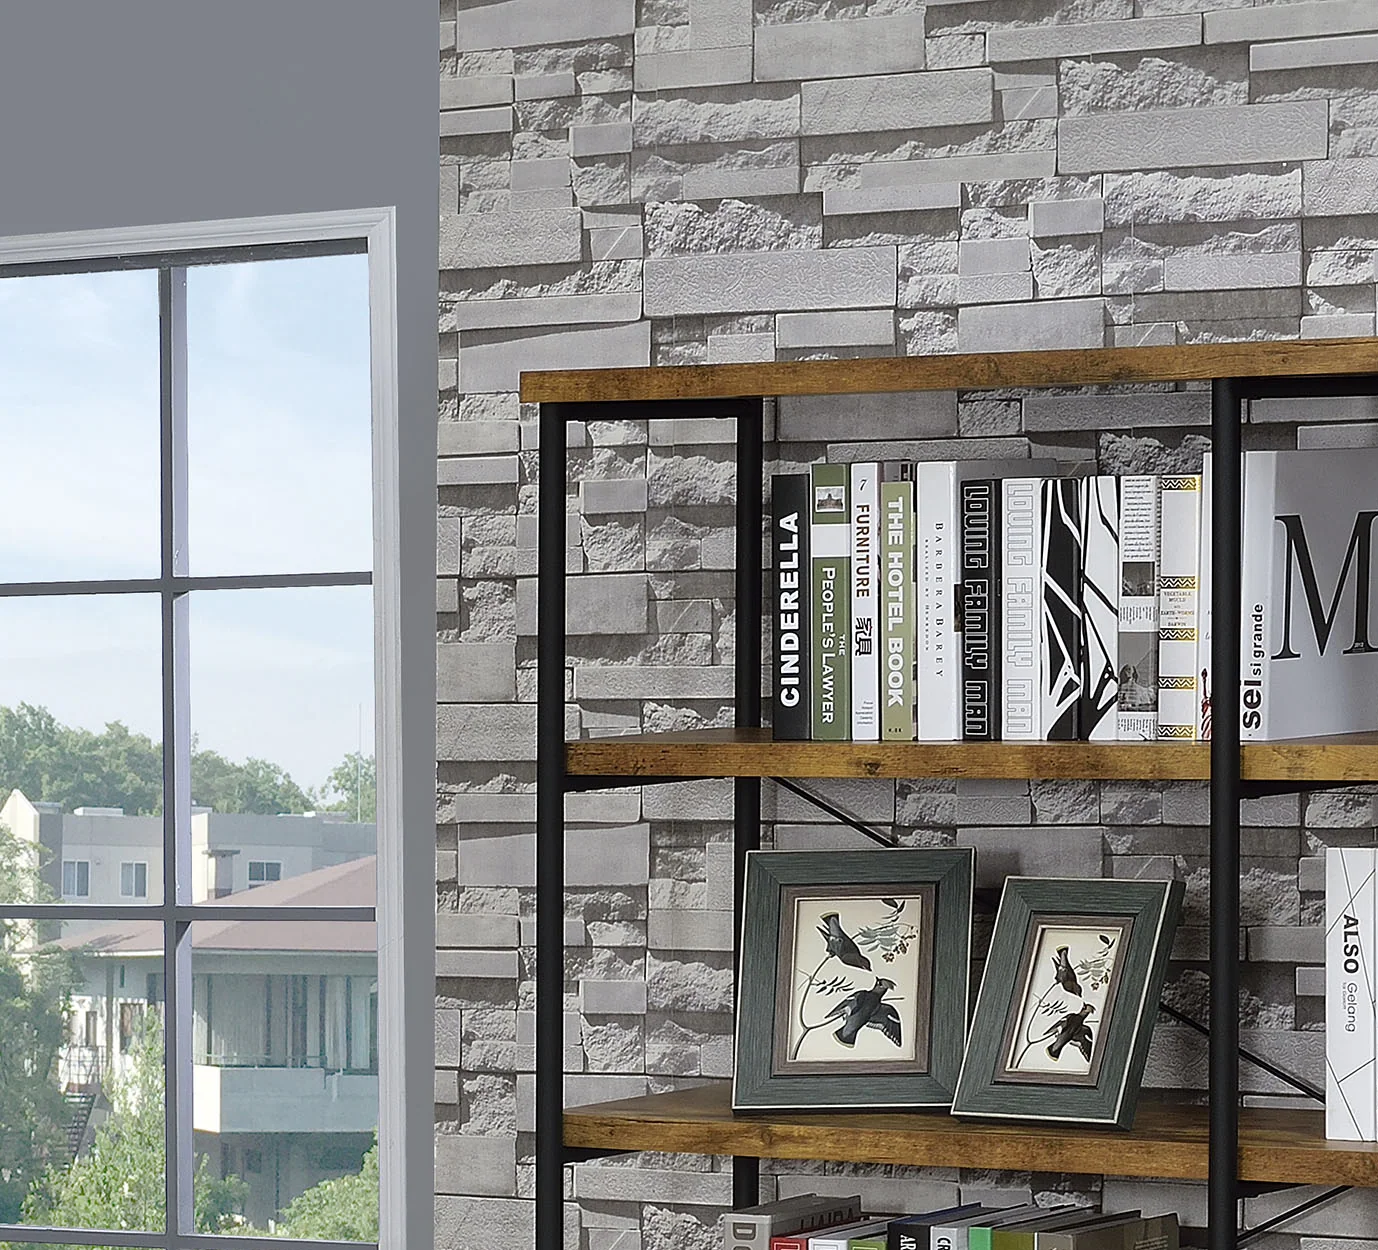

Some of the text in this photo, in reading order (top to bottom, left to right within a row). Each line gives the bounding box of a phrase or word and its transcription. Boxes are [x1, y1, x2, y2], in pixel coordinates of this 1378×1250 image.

[855, 504, 870, 598] FURNITURE
[887, 496, 904, 546] THE
[779, 512, 800, 707] CINDERELLA
[887, 553, 904, 631] HOTEL
[838, 634, 846, 656] THE
[854, 617, 873, 656] 家具
[964, 579, 989, 671] FAMILY
[1006, 577, 1033, 668] FAMILY
[1251, 604, 1265, 658] grande
[822, 653, 836, 724] LAWYER
[887, 638, 904, 707] BOOK
[965, 680, 990, 736] MAN
[1006, 679, 1033, 733] MAN
[1343, 914, 1359, 974] ALSO
[1344, 982, 1358, 1032] Gelang
